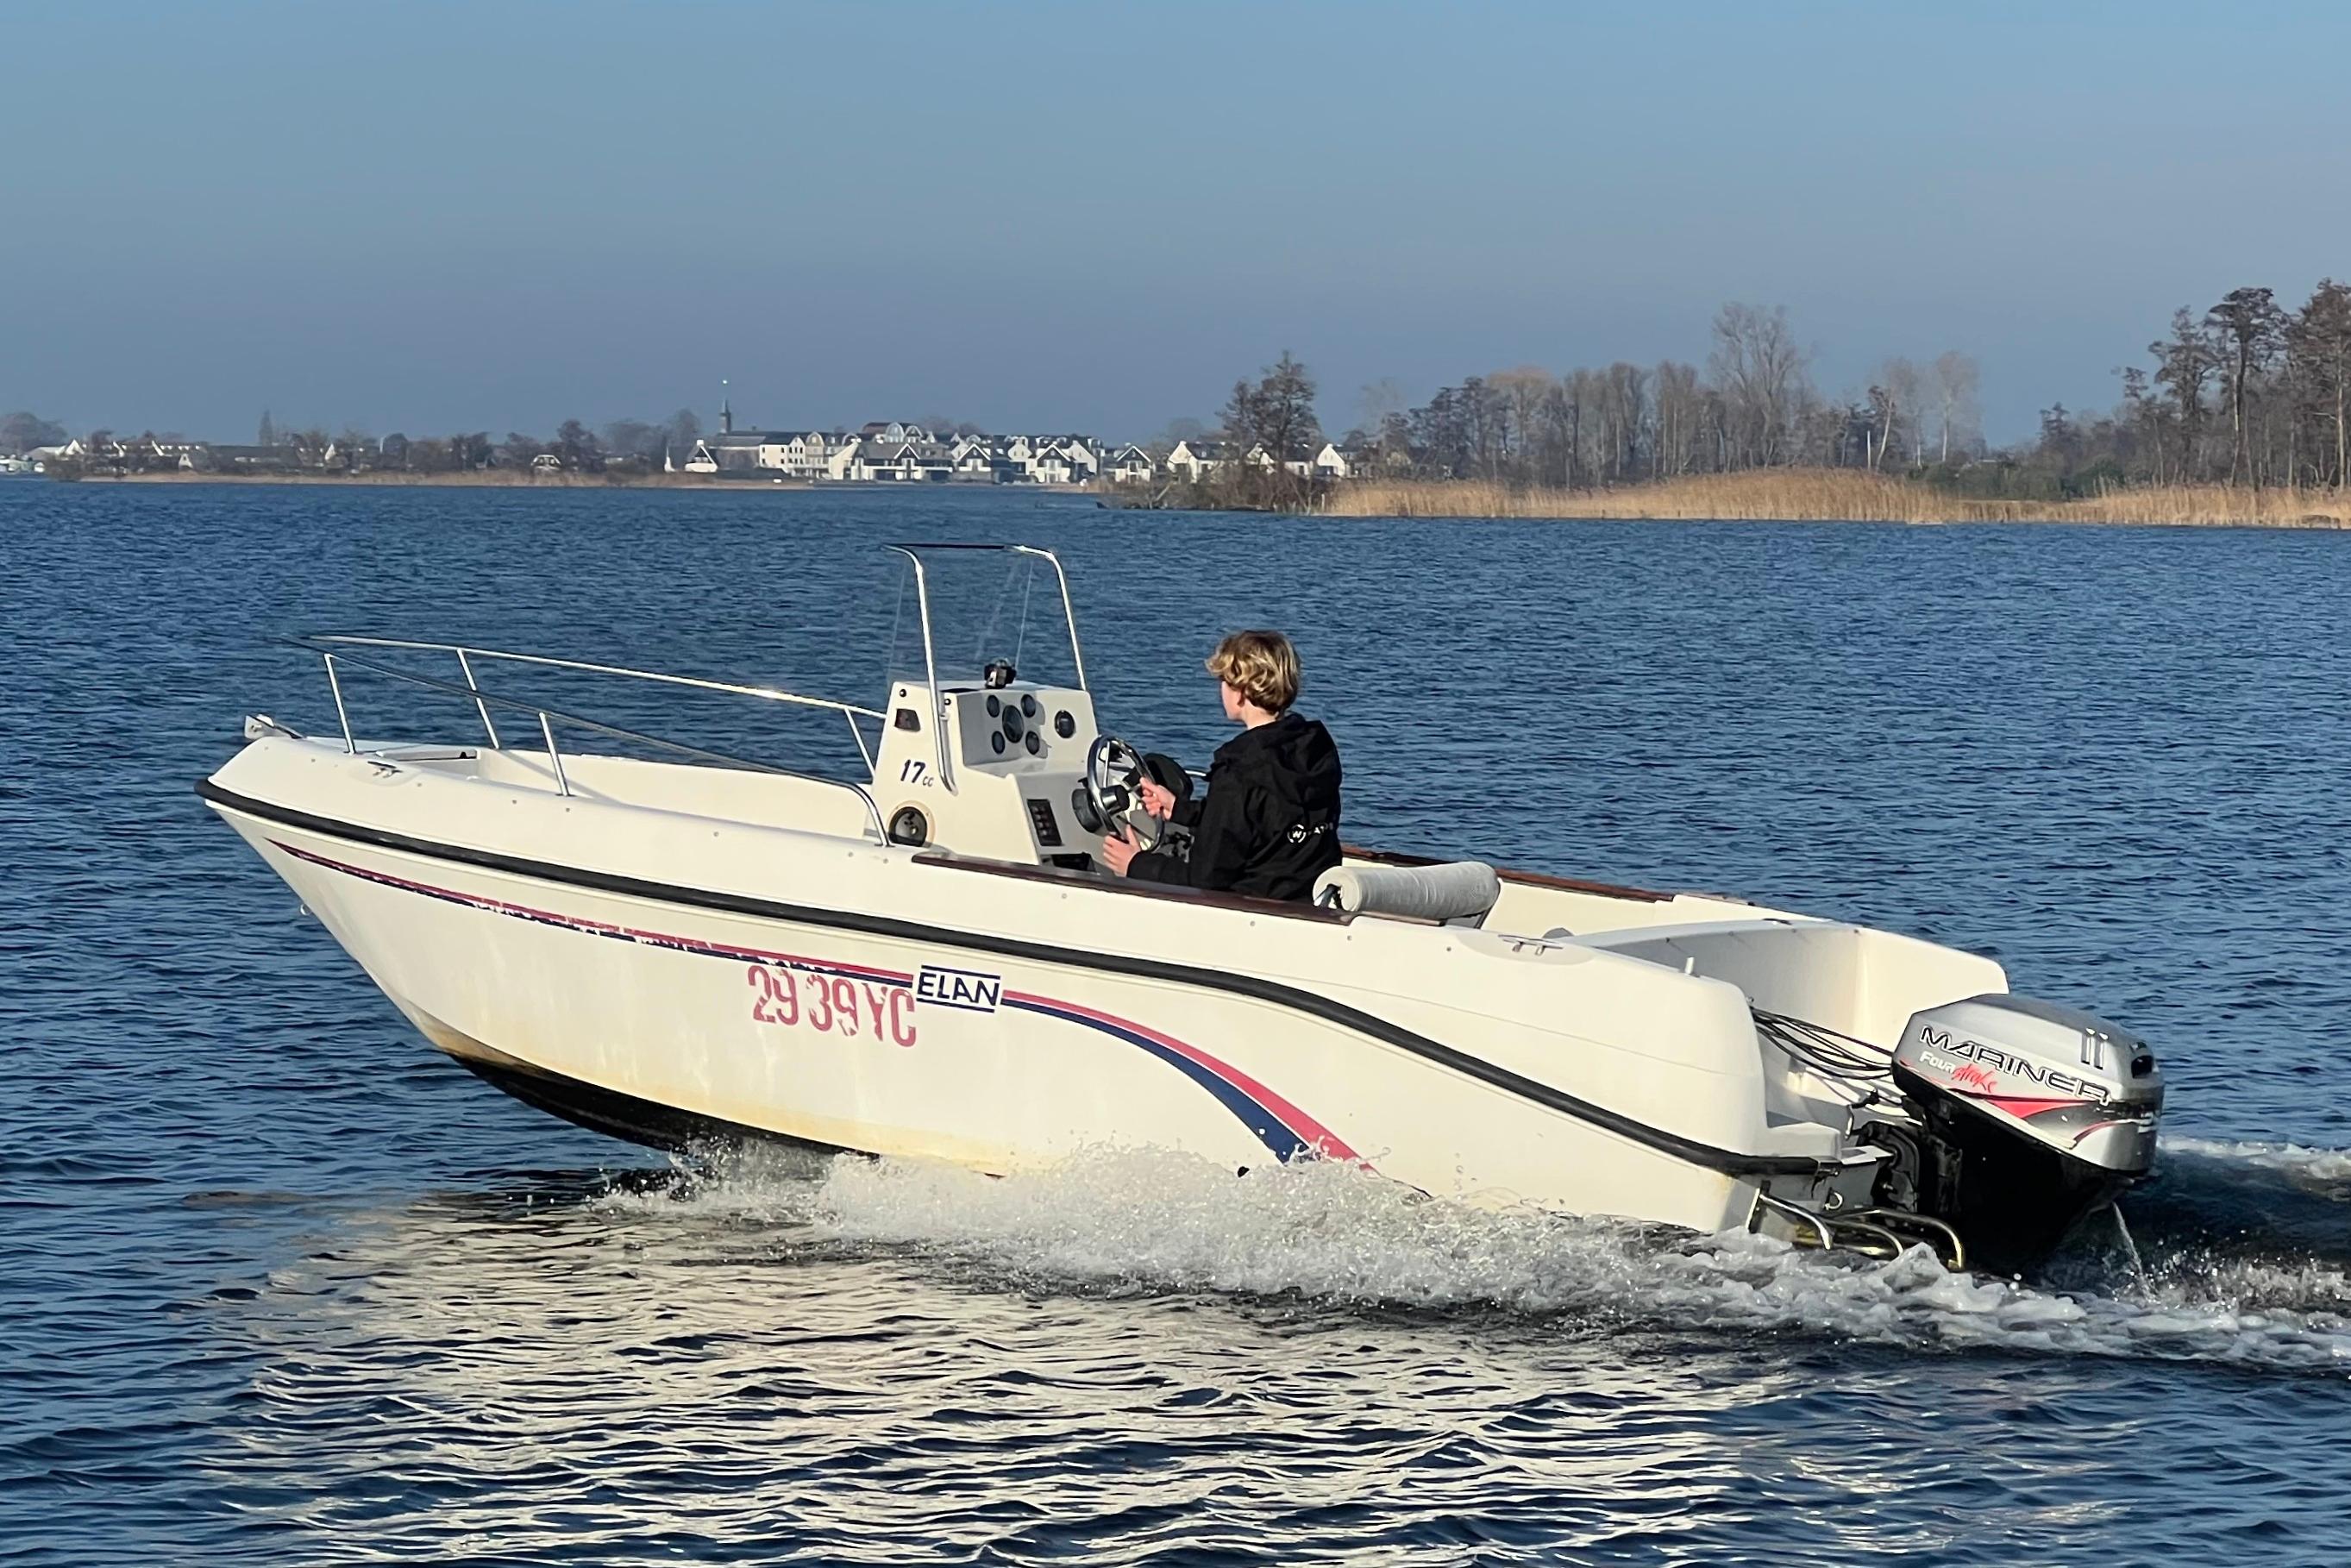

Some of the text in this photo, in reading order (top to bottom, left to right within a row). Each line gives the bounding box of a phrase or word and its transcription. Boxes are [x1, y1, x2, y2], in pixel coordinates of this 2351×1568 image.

[900, 759, 926, 784] 17
[748, 964, 917, 1047] 29 39 YC
[917, 971, 1000, 1007] ELAN
[1919, 1025, 2114, 1107] MARINER
